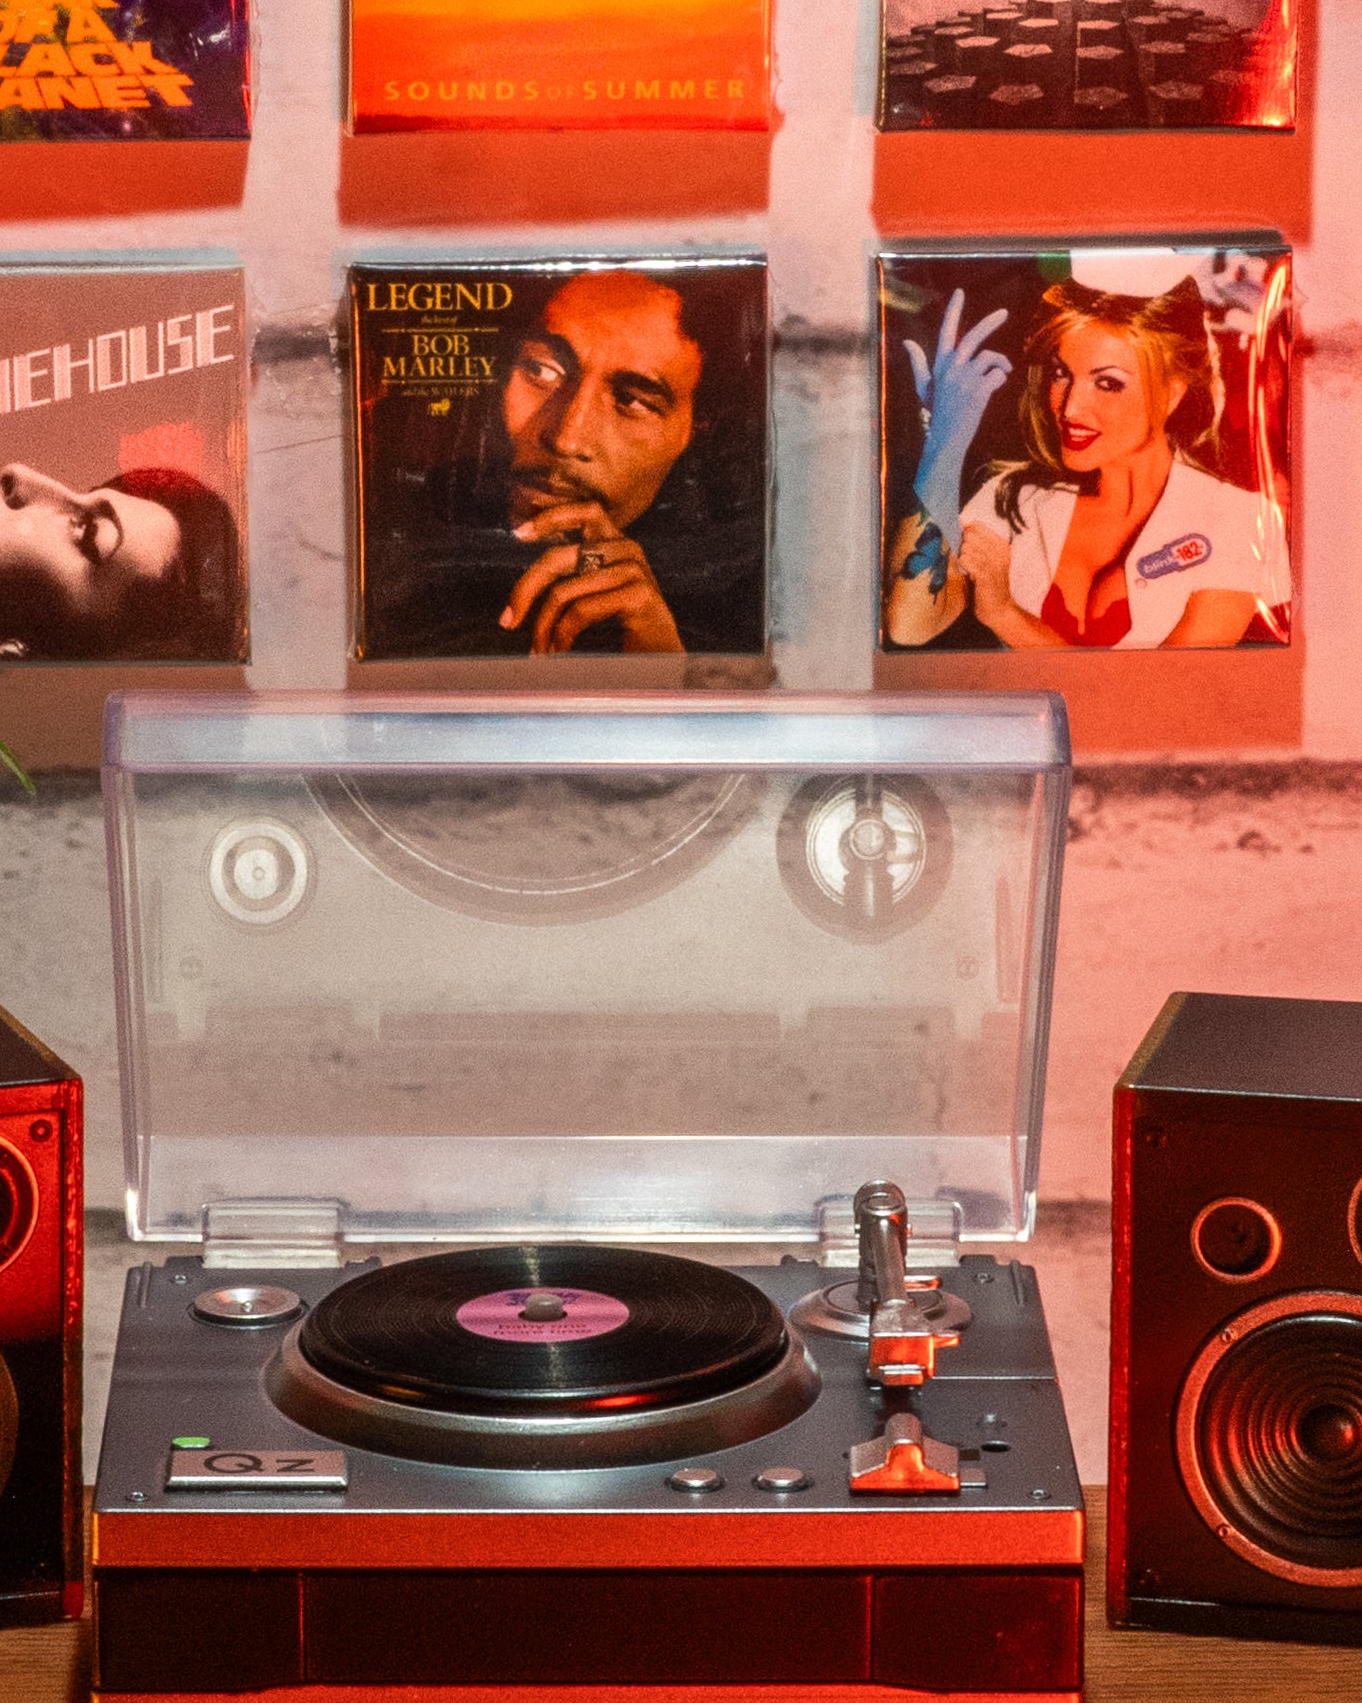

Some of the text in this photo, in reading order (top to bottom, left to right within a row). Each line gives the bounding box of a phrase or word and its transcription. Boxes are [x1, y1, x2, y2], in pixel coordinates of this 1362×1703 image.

[66, 7, 119, 44] A
[383, 79, 541, 103] SOUNDS
[582, 79, 746, 102] SUMMER
[366, 282, 514, 312] LEGEND
[411, 334, 470, 356] BOB
[382, 356, 497, 377] MARLEY
